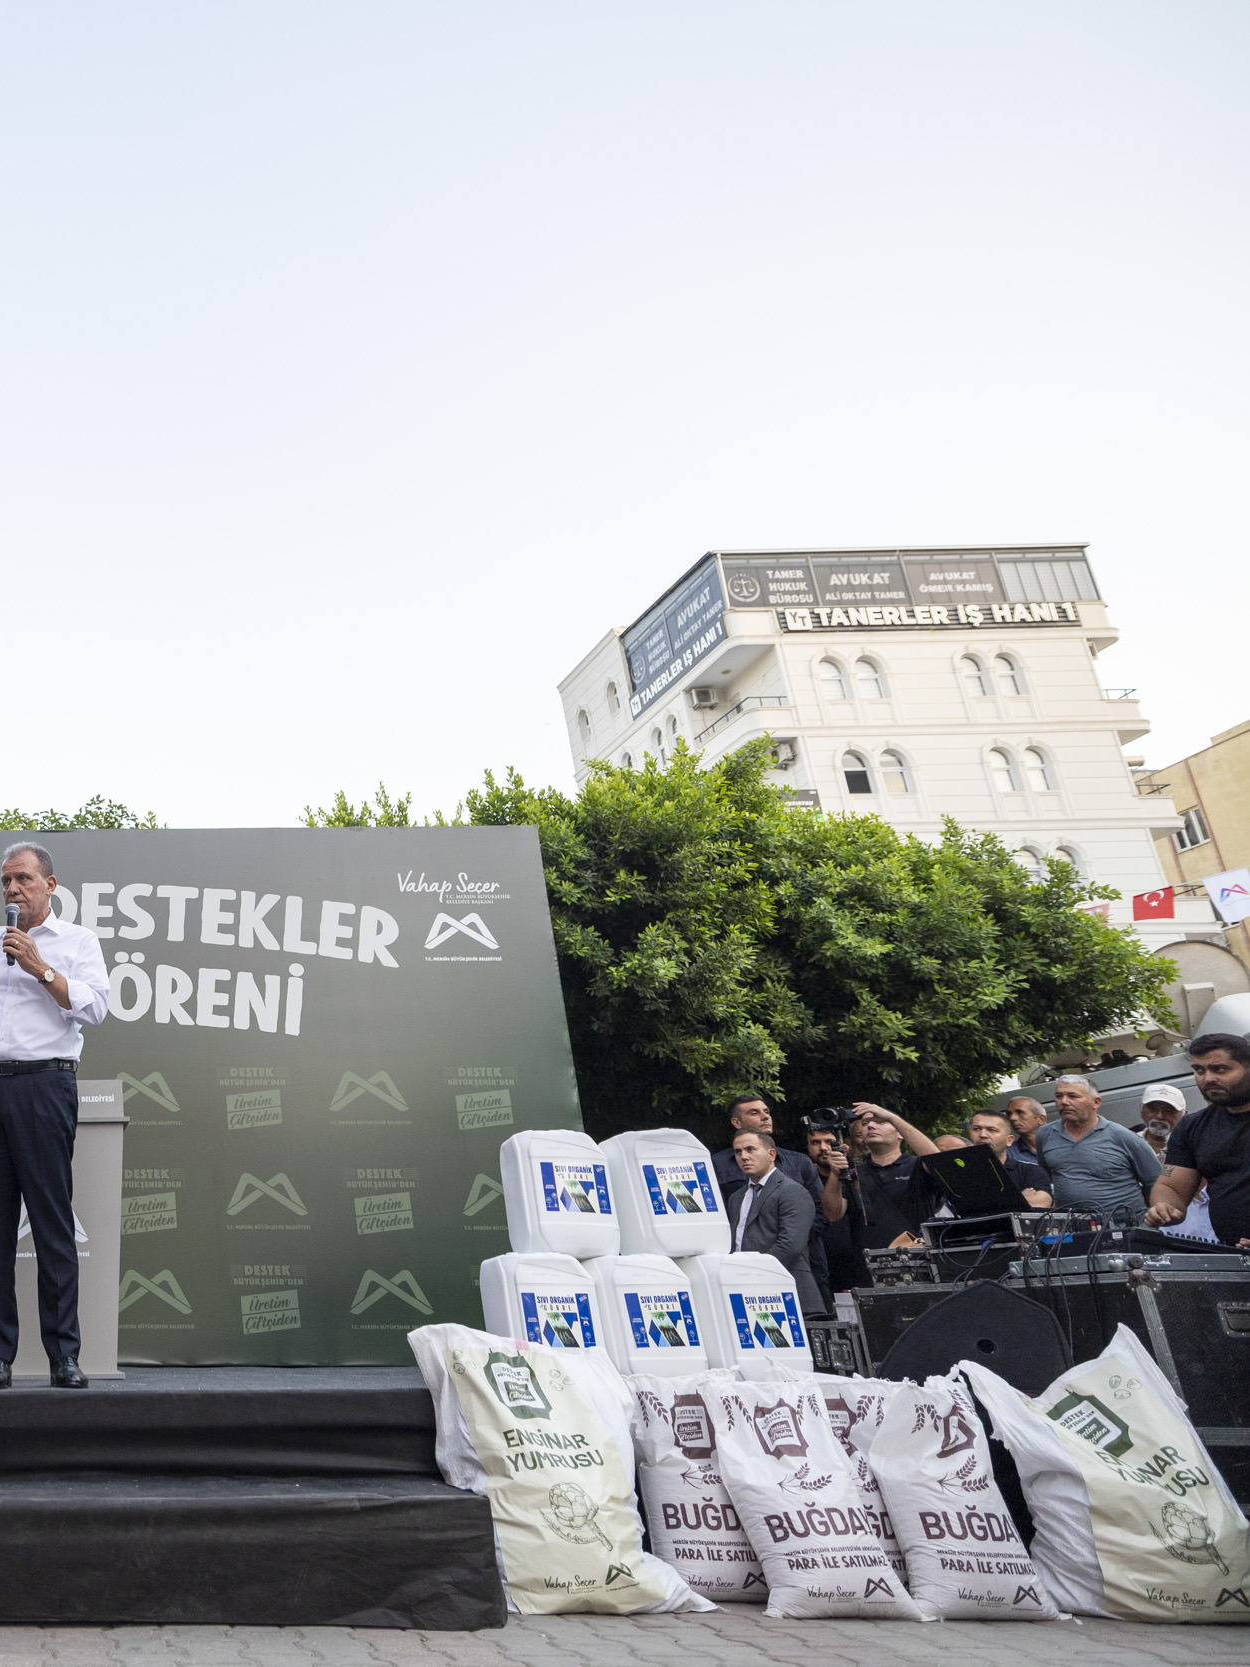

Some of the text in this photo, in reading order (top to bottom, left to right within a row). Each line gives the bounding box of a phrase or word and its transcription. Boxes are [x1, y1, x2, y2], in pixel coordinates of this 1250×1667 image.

[766, 570, 805, 580] TANER
[829, 573, 891, 586] AVUKAT
[929, 571, 976, 581] AVUKAT
[768, 582, 809, 592] HUKUK
[919, 583, 994, 593] ÖMER KAMIŞ
[769, 593, 814, 604] BÜROSU
[842, 592, 872, 600] OKTAY
[873, 591, 906, 600] TANER
[677, 586, 711, 629] AVUKAT
[813, 602, 1077, 627] TANERLER İŞ HANI 1
[640, 657, 684, 706] TANERLER
[693, 626, 717, 658] HANI
[397, 870, 501, 904] Vahap Seçer
[108, 951, 305, 1037] ÖRENİ
[458, 1067, 503, 1077] DESTEK
[81, 1094, 115, 1103] BELEDİYESİ
[463, 1095, 503, 1110] Üretim
[460, 1111, 512, 1129] Çiftçiden
[124, 1169, 170, 1180] DESTEK
[568, 1165, 593, 1174] ORGANİK
[656, 1164, 694, 1175] SIVI ORGANİK
[122, 1180, 182, 1190] YÜKŞEHİR'DEN
[128, 1198, 168, 1214] Üretim
[123, 1215, 176, 1234] Çiftçiden
[244, 1265, 291, 1276] DESTEK
[249, 1295, 291, 1313] Üretim
[536, 1294, 576, 1304] SIVI ORGANİK
[640, 1293, 678, 1304] SIVI ORGANİK
[745, 1294, 783, 1304] SIVI ORGANİK
[245, 1313, 299, 1331] Çiftçiden
[503, 1428, 590, 1450] ENGİNAR
[506, 1449, 605, 1472] YUMRUSU
[662, 1496, 745, 1532] BUĞD
[918, 1504, 1023, 1543] BUĞDA
[675, 1546, 759, 1562] PARA İLE SATIL
[787, 1556, 821, 1571] PARA
[821, 1554, 840, 1569] İLE
[841, 1555, 889, 1569] SATILMAZ
[940, 1557, 975, 1573] PARA
[976, 1558, 995, 1574] İLE
[543, 1575, 573, 1594] Vahap
[688, 1575, 714, 1591] Vahap
[806, 1585, 835, 1602] Vahap
[958, 1587, 985, 1606] Vahap
